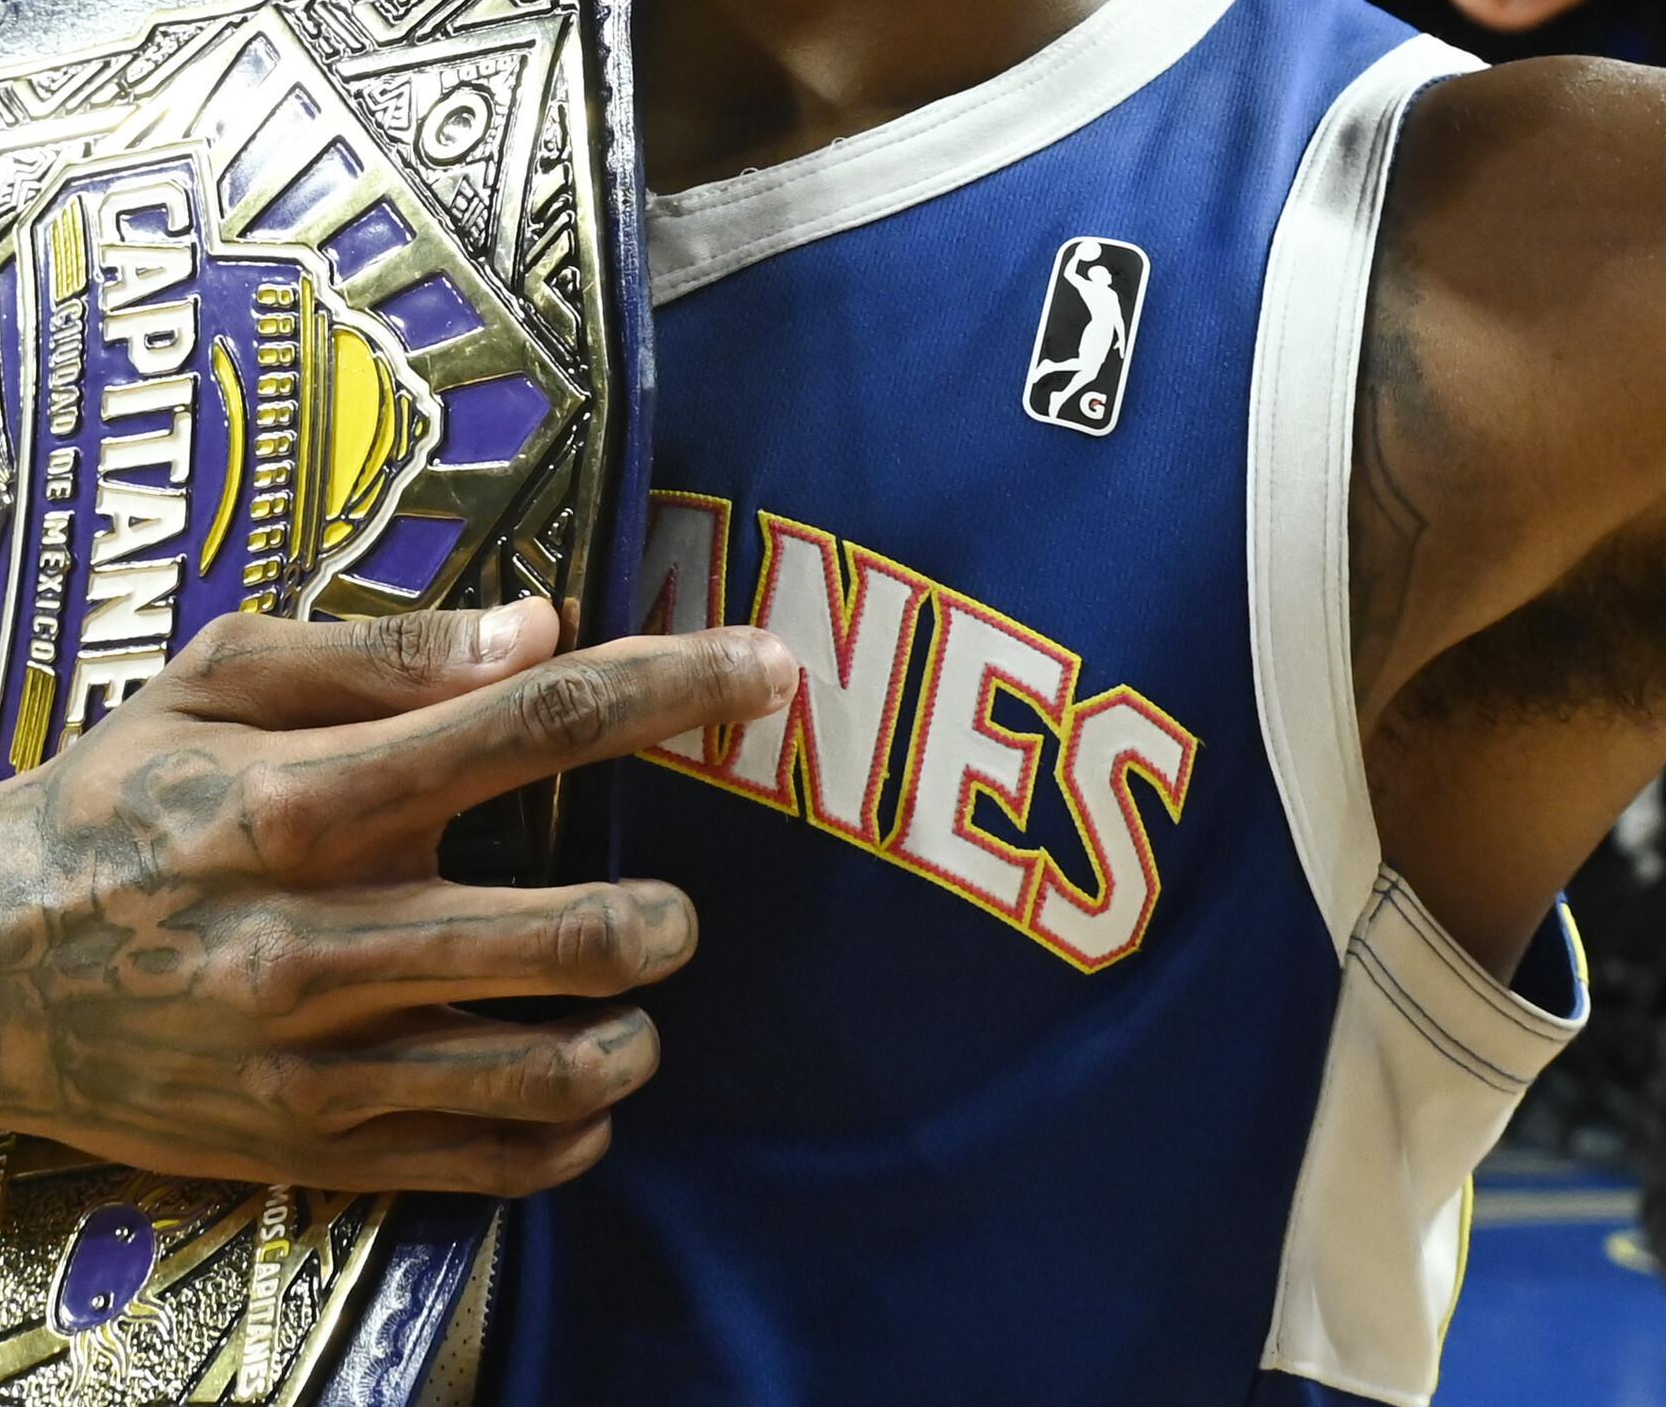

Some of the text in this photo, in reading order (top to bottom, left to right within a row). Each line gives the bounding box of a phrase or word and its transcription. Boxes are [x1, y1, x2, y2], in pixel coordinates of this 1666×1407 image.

[50, 297, 85, 436] CIUDAD
[45, 447, 81, 501] DE
[57, 179, 197, 751] CAPITANE
